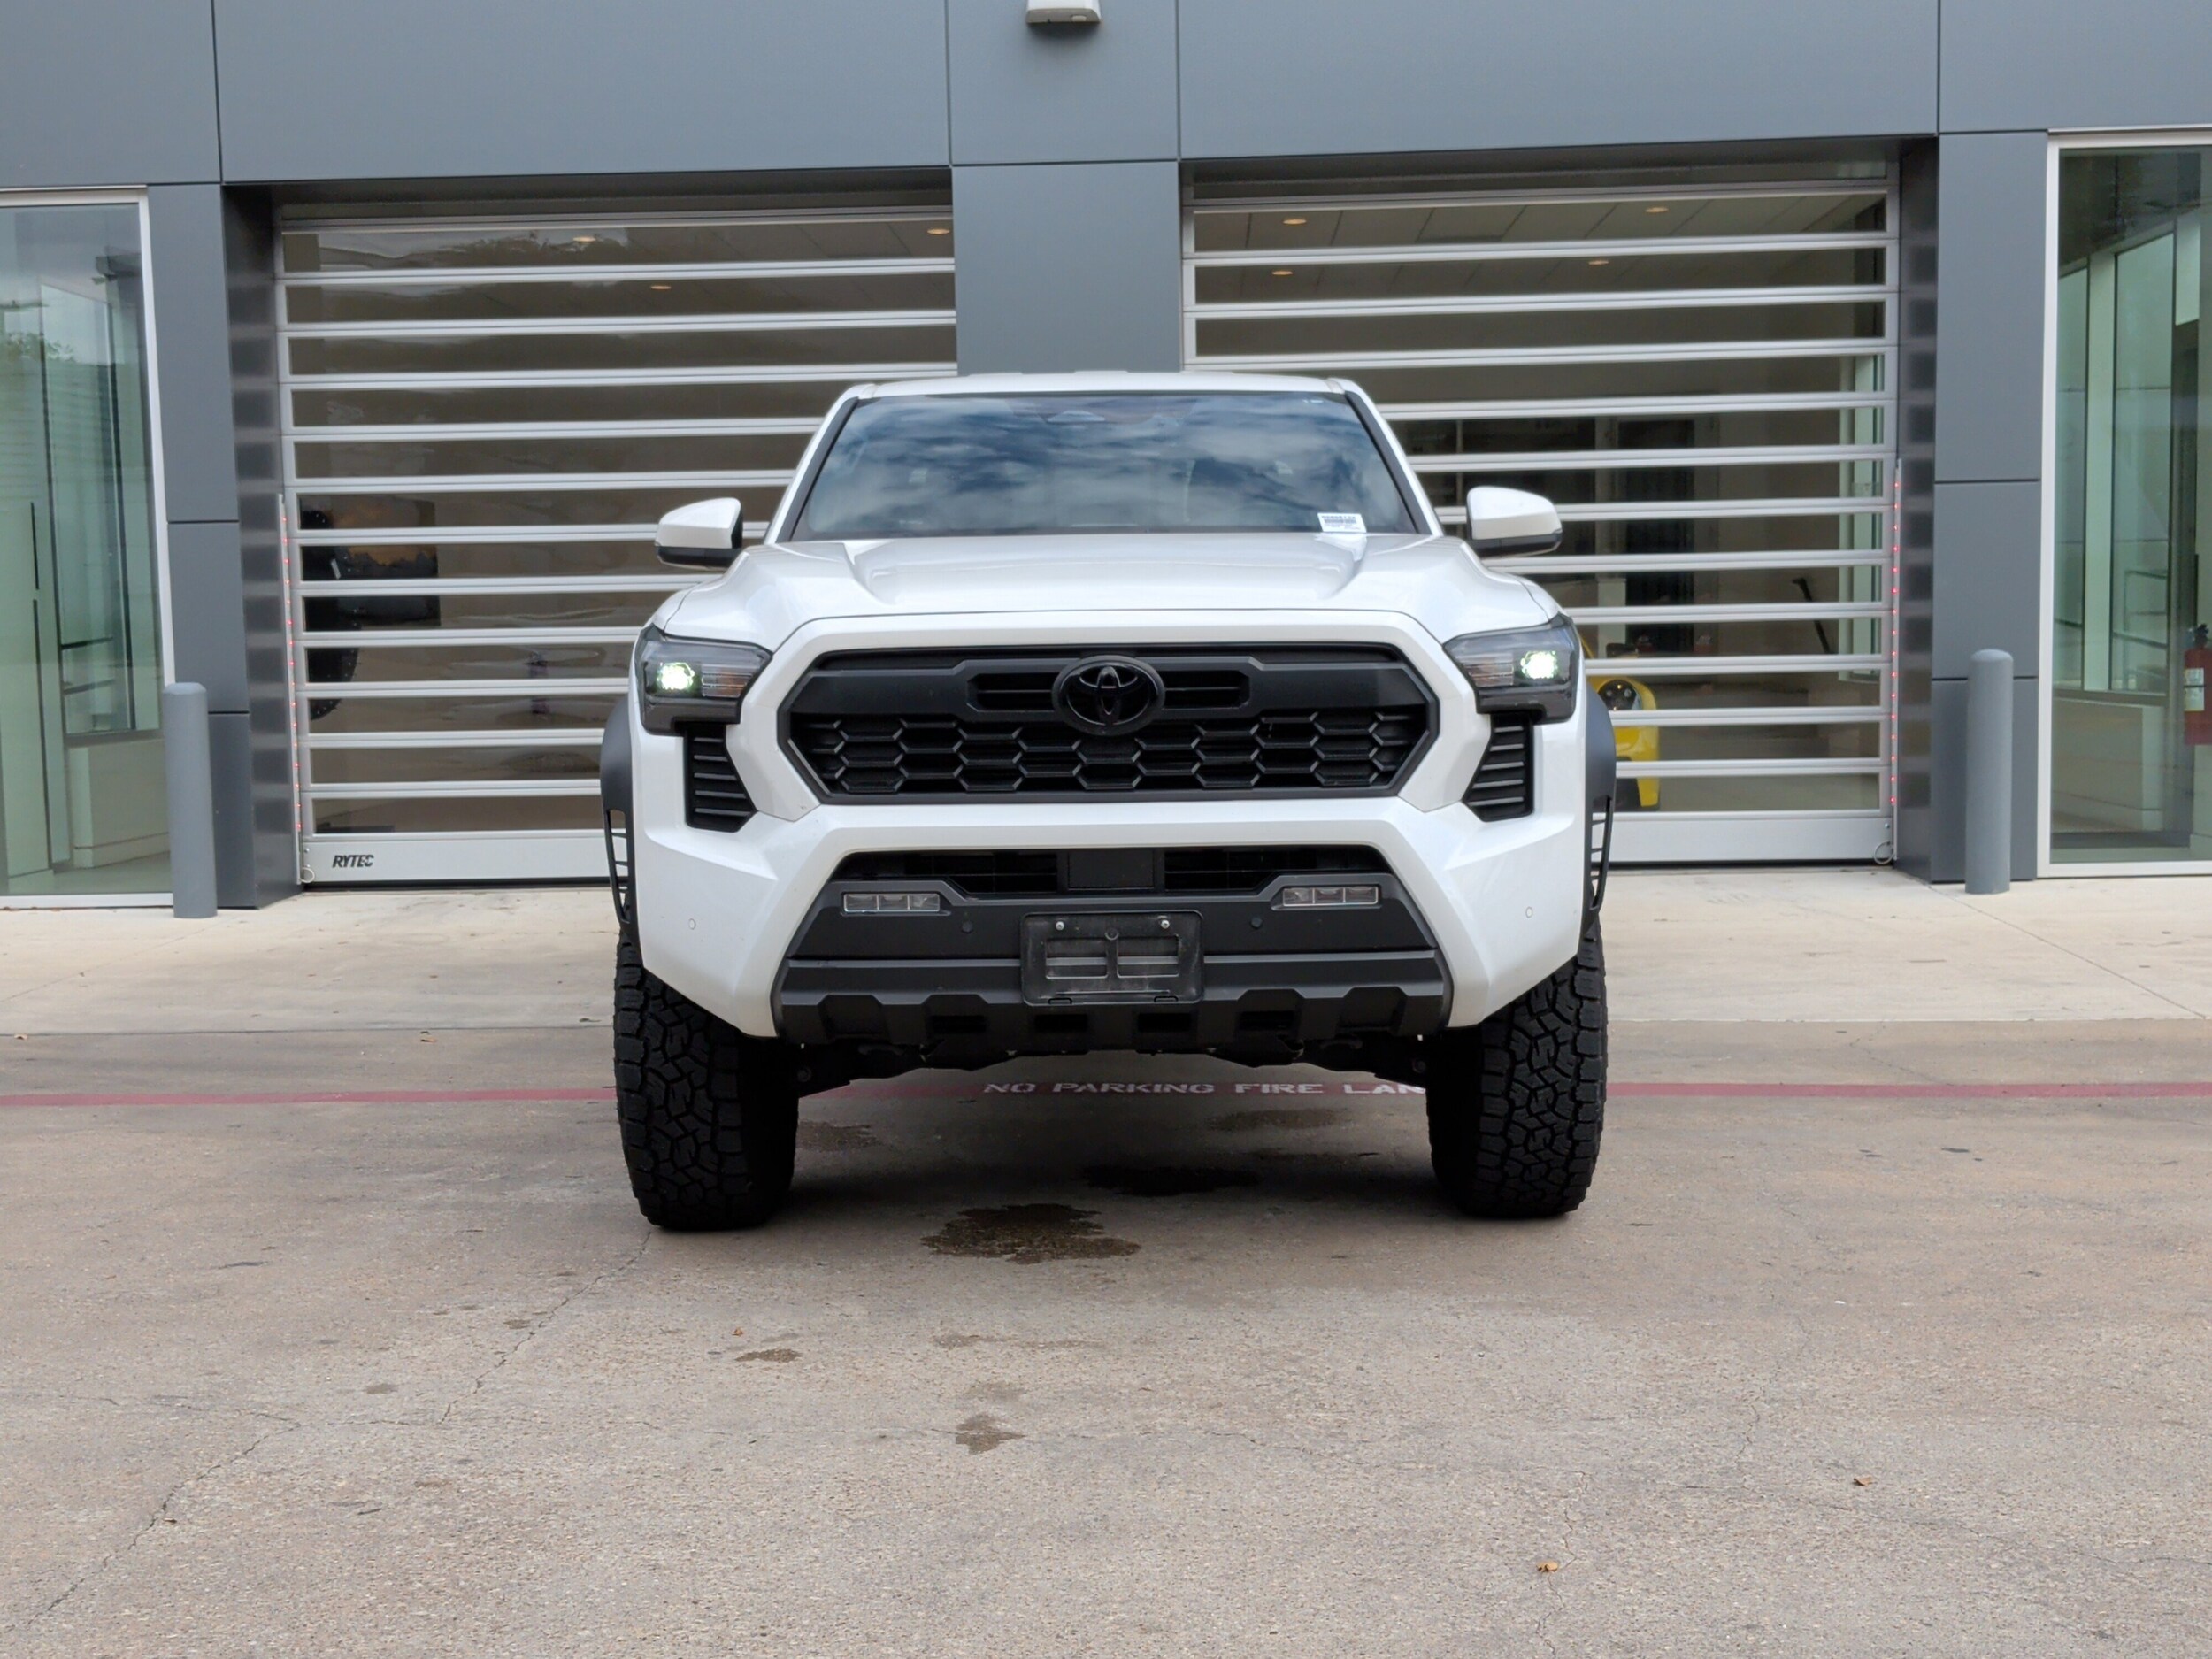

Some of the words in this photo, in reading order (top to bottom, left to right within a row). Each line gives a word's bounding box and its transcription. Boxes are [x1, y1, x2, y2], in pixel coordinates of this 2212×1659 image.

[332, 854, 374, 868] RYTEC
[983, 1083, 1036, 1093] NO
[1052, 1082, 1215, 1094] PARKING
[1235, 1083, 1324, 1094] FIRE
[1343, 1083, 1426, 1094] LAN
